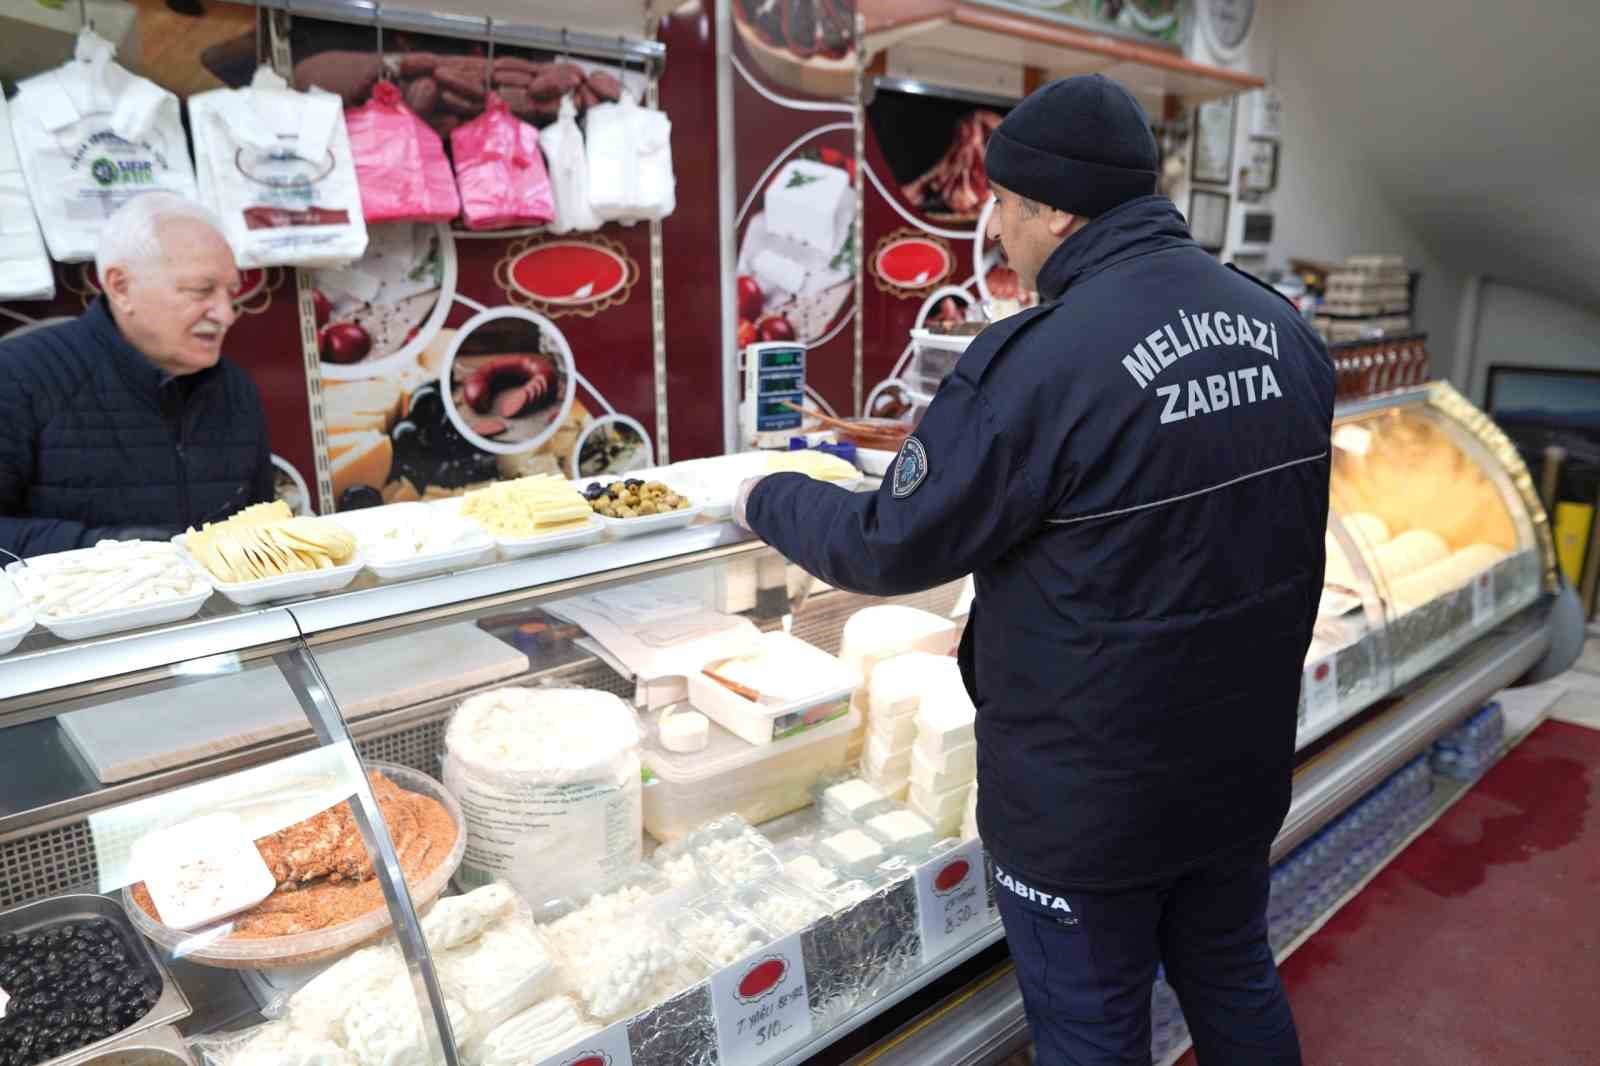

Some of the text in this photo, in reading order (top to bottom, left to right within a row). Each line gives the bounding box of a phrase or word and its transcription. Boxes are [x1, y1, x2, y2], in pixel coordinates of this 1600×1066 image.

[1121, 309, 1279, 389] MELİKGAZİ
[1156, 364, 1283, 424] ZABITA
[995, 865, 1072, 913] ZABITA
